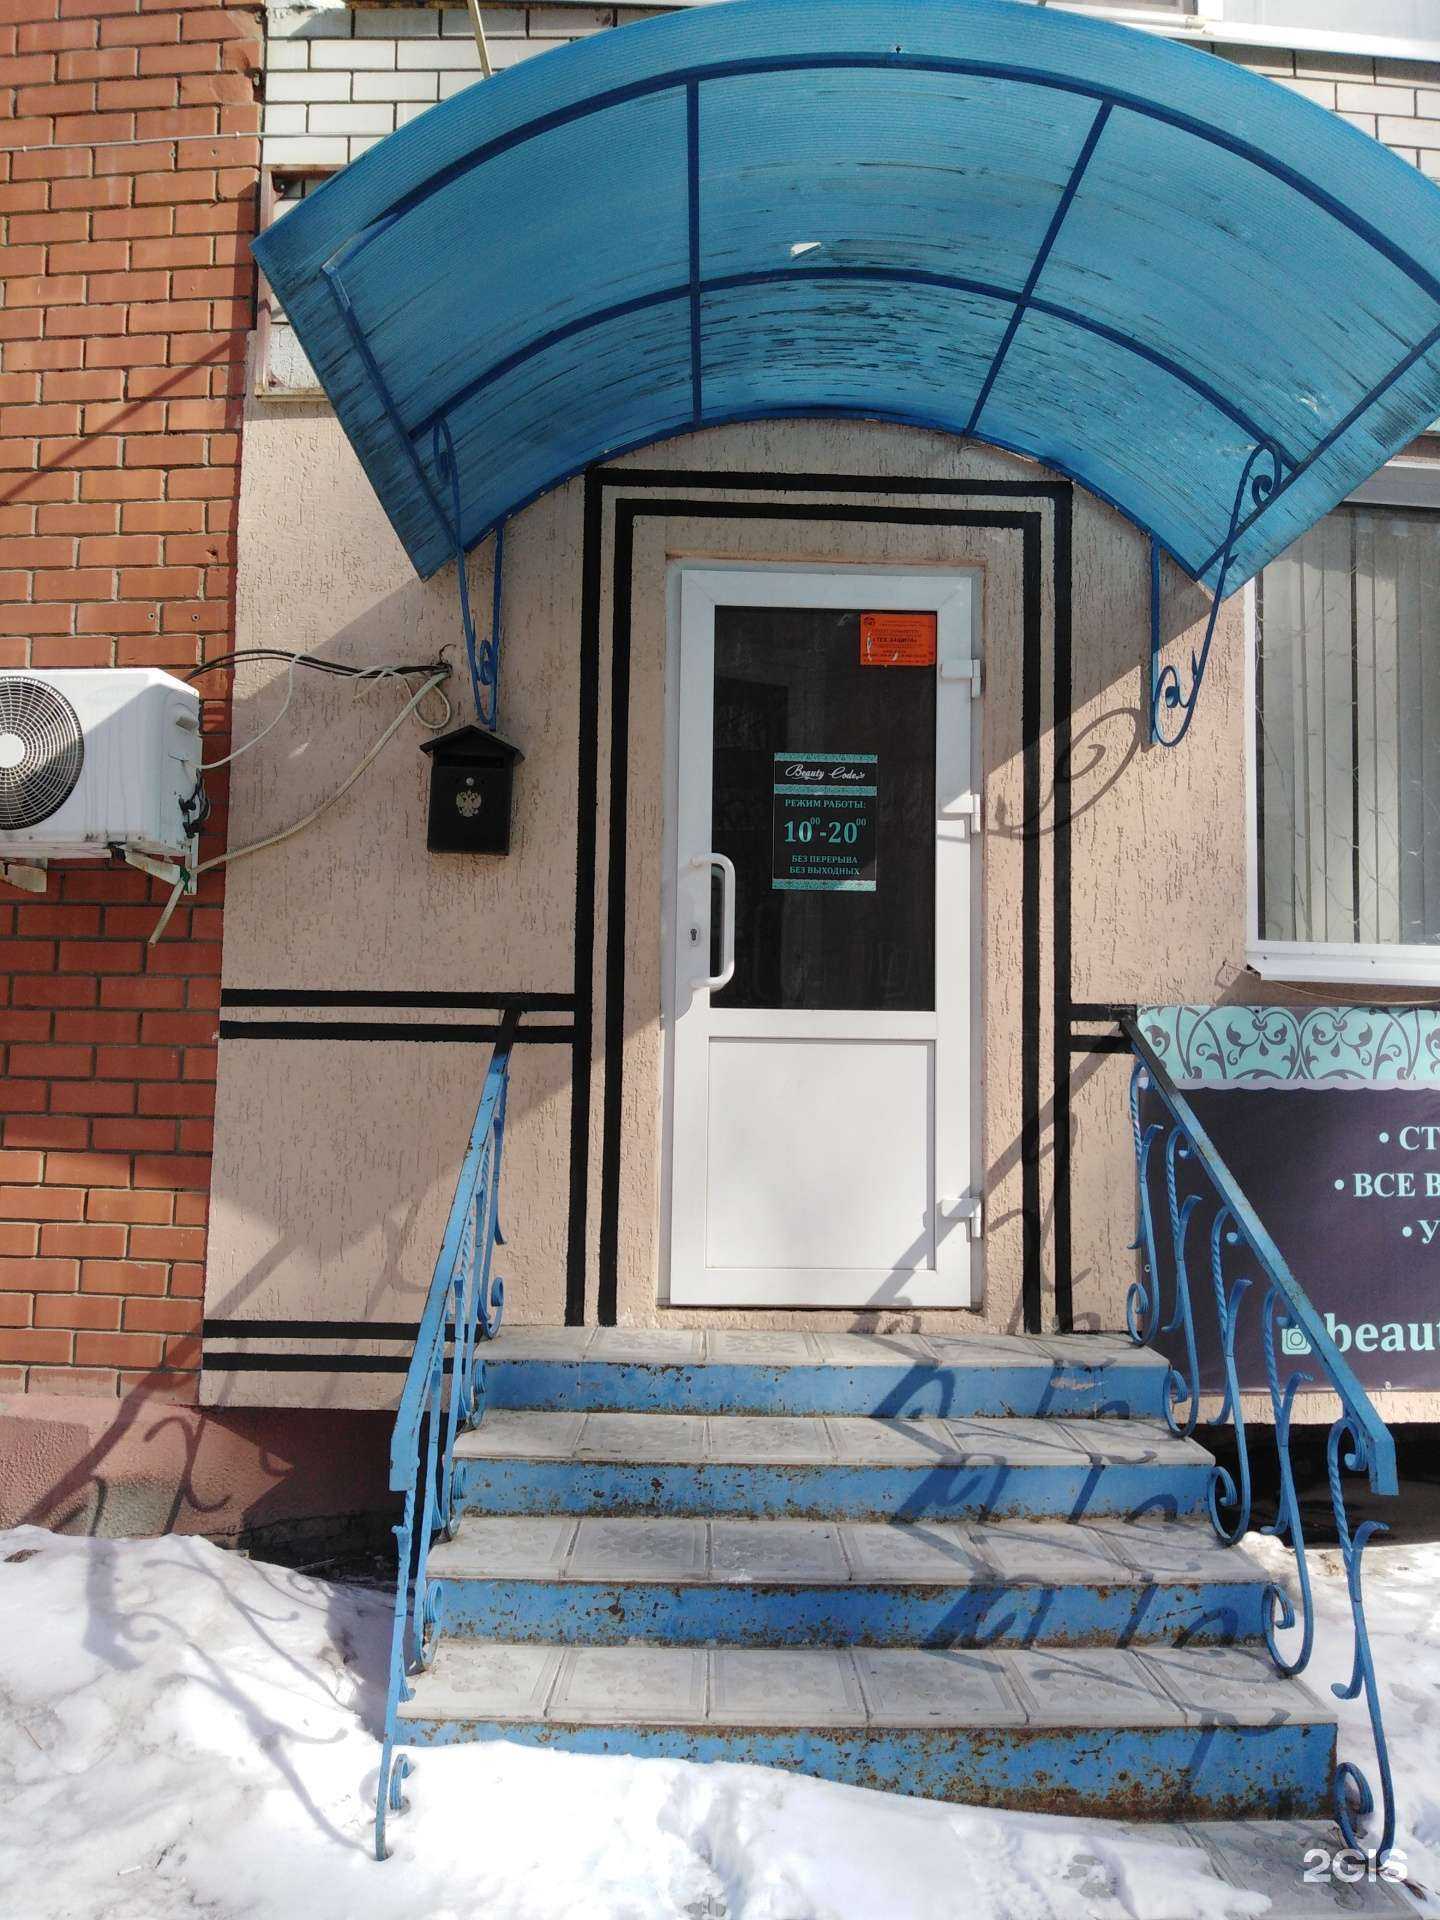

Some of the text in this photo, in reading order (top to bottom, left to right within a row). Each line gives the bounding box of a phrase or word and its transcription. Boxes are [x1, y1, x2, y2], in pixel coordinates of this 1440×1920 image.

[785, 763, 859, 781] Beauty Code
[785, 799, 866, 809] РЕЖИМ РАБОТЫ:
[791, 854, 858, 864] БЕЗ ПЕРЕРЫВА
[789, 866, 860, 876] БЕЗ ВЫХОДНЫХ
[1352, 1172, 1416, 1197] ВСЕ
[1324, 1313, 1440, 1353] beau
